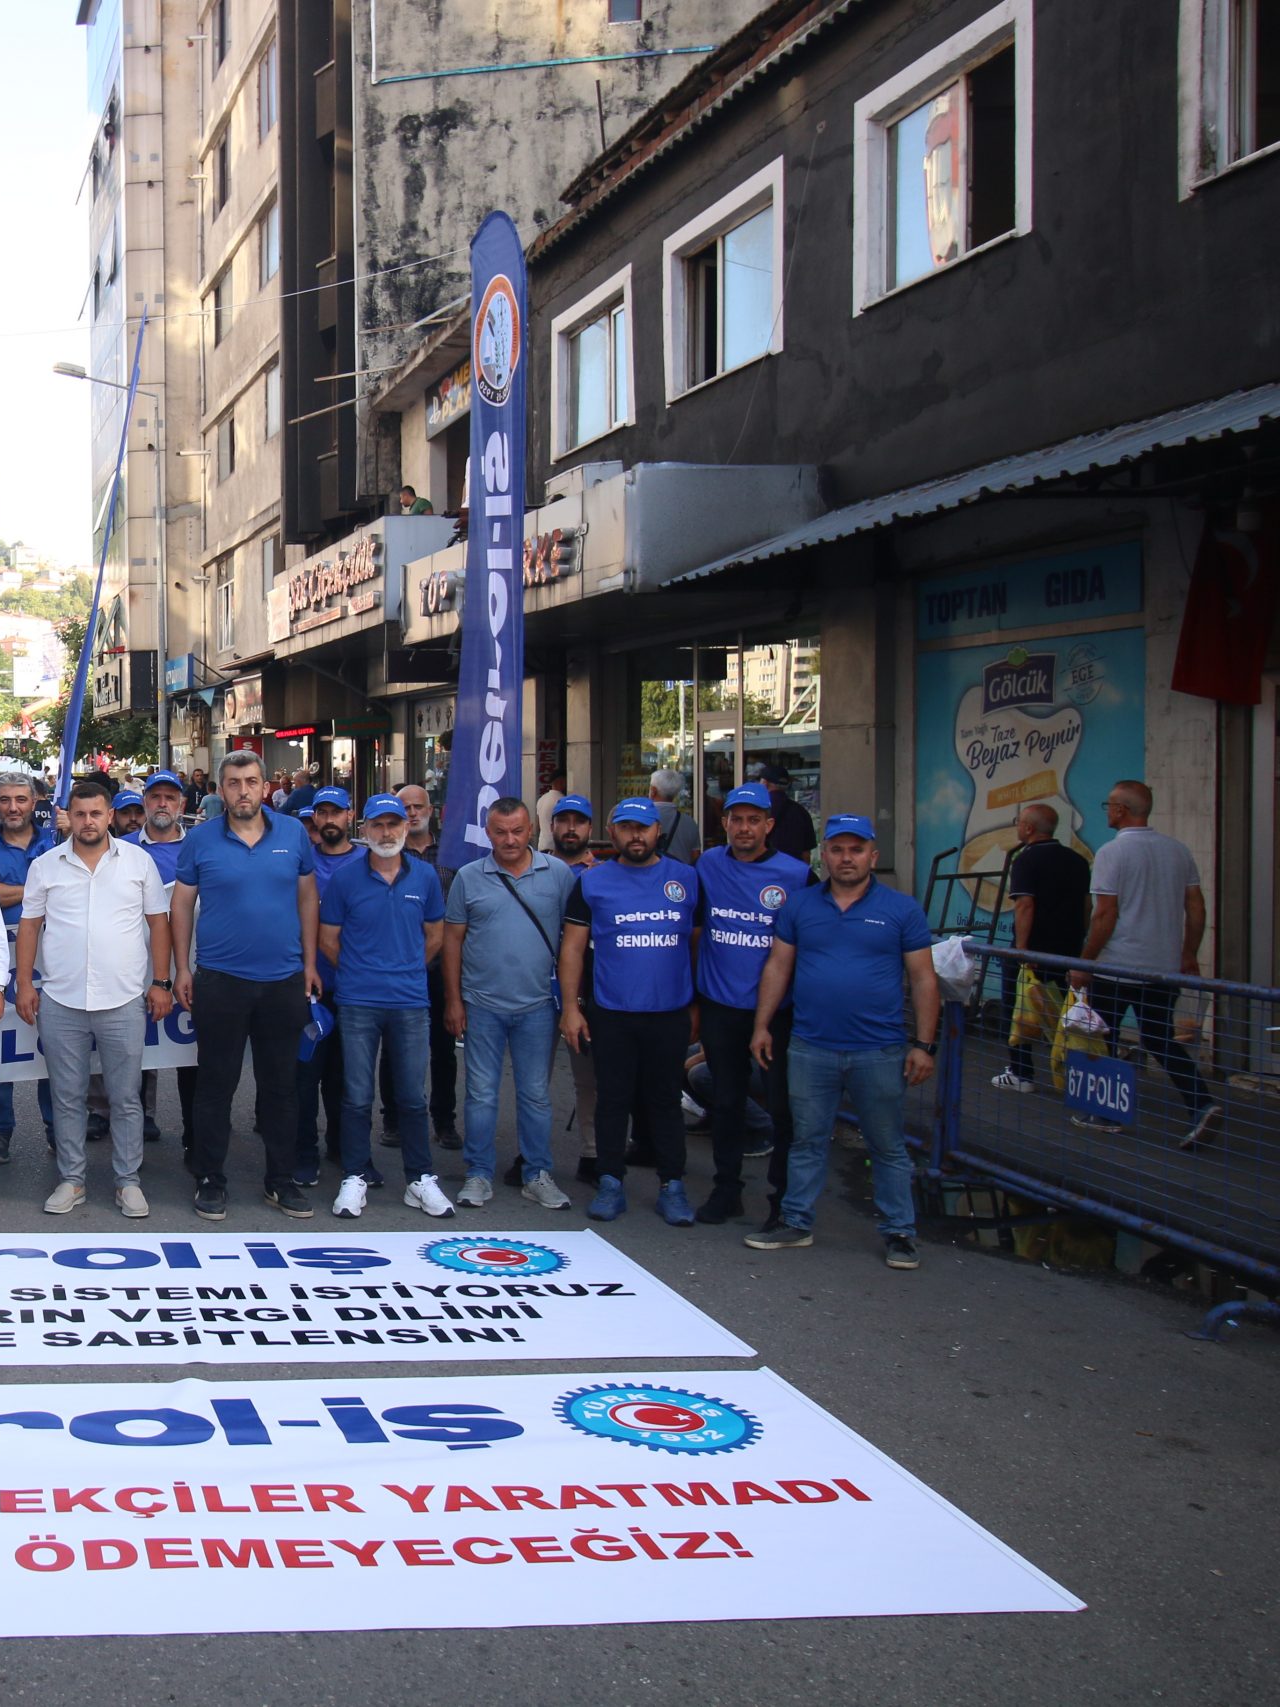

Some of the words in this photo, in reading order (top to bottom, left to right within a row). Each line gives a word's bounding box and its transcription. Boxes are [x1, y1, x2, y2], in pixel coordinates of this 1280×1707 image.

[924, 581, 1008, 625] TOPTAN
[1045, 565, 1107, 609] GIDA
[1071, 664, 1095, 685] EGE
[988, 669, 1049, 704] Gölcük
[990, 725, 1017, 744] Taze
[966, 740, 1021, 780] Beyaz
[1024, 719, 1082, 764] Peynir
[614, 909, 681, 925] petrol-iş
[711, 906, 773, 926] petrol-iş
[616, 931, 679, 948] SENDİKASI
[711, 928, 773, 948] SENDİKASI
[1068, 1066, 1084, 1098] 67
[1086, 1071, 1130, 1113] POLİS
[10, 1284, 268, 1302] SİSTEMİ
[289, 1281, 637, 1300] İSTİYORUZ
[108, 1304, 313, 1323] VERGİ
[334, 1302, 543, 1322] DİLİMİ
[42, 1327, 520, 1347] SABİTLENSİN!
[583, 1392, 654, 1419] TÜRK
[638, 1429, 726, 1443] 1952
[384, 1479, 870, 1513] YARATMADI
[15, 1528, 753, 1572] ÖDEMEYECEĞİZ!
